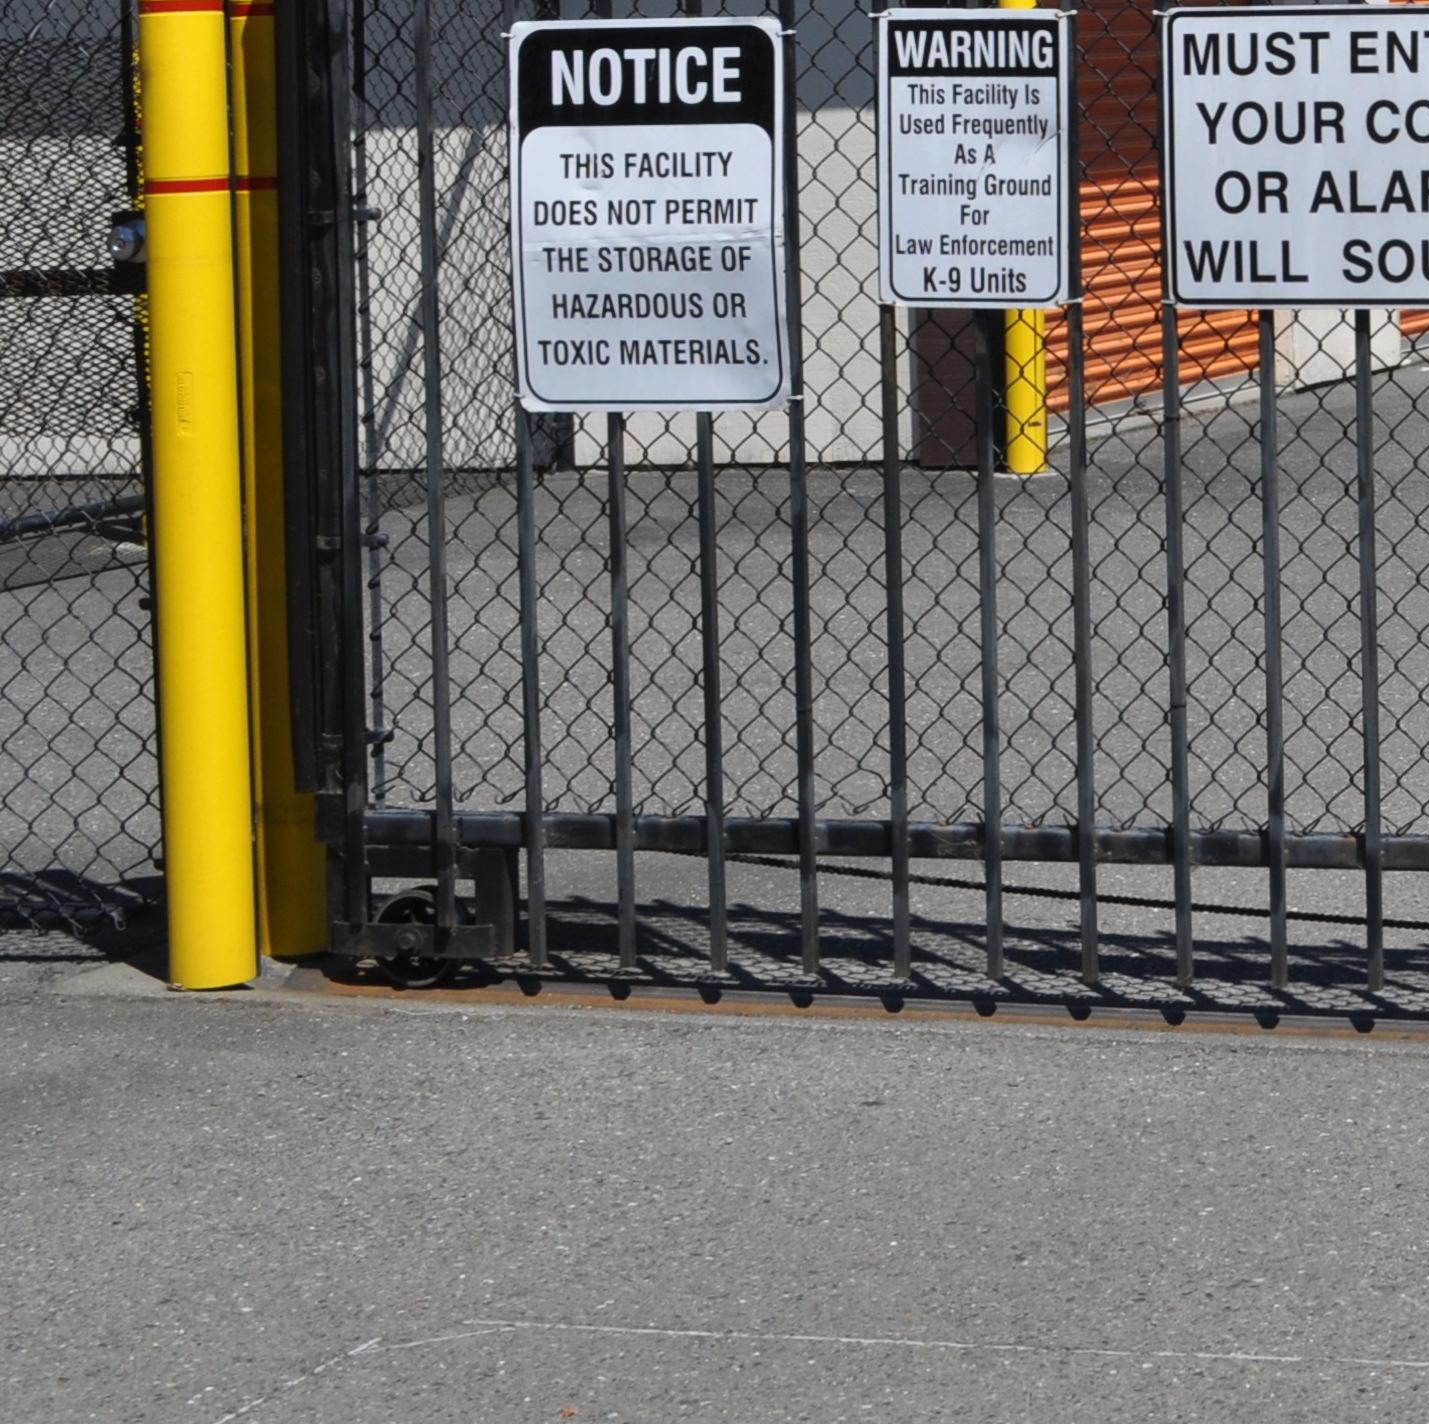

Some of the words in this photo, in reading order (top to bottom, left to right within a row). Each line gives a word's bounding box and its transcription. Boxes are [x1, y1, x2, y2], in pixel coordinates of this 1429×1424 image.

[895, 30, 1052, 68] WARNING
[1184, 32, 1330, 76] MUST
[552, 47, 741, 105] NOTICE
[908, 84, 945, 104] This
[953, 84, 1018, 109] Facility
[1025, 84, 1039, 105] Is
[900, 114, 944, 134] Used
[953, 114, 1048, 140] Frequently
[1197, 101, 1344, 145] YOUR
[560, 153, 614, 178] THIS
[625, 152, 732, 178] FACILITY
[955, 144, 976, 164] As
[984, 144, 995, 164] A
[899, 174, 976, 200] Training
[985, 174, 1051, 196] Ground
[1215, 171, 1288, 214] OR
[534, 200, 597, 226] DOES
[608, 200, 656, 225] NOT
[666, 199, 757, 224] PERMIT
[961, 205, 989, 225] For
[895, 234, 932, 256] Law
[940, 235, 1053, 256] Enforcement
[543, 248, 589, 272] THE
[599, 246, 712, 272] STORAGE
[721, 246, 750, 272] OF
[1184, 241, 1308, 282] WILL
[924, 267, 960, 292] K-9
[971, 267, 1026, 293] Units
[553, 293, 703, 318] HAZARDOUS
[713, 293, 746, 318] OR
[538, 340, 610, 365] TOXIC
[620, 339, 768, 365] MATERIALS.
